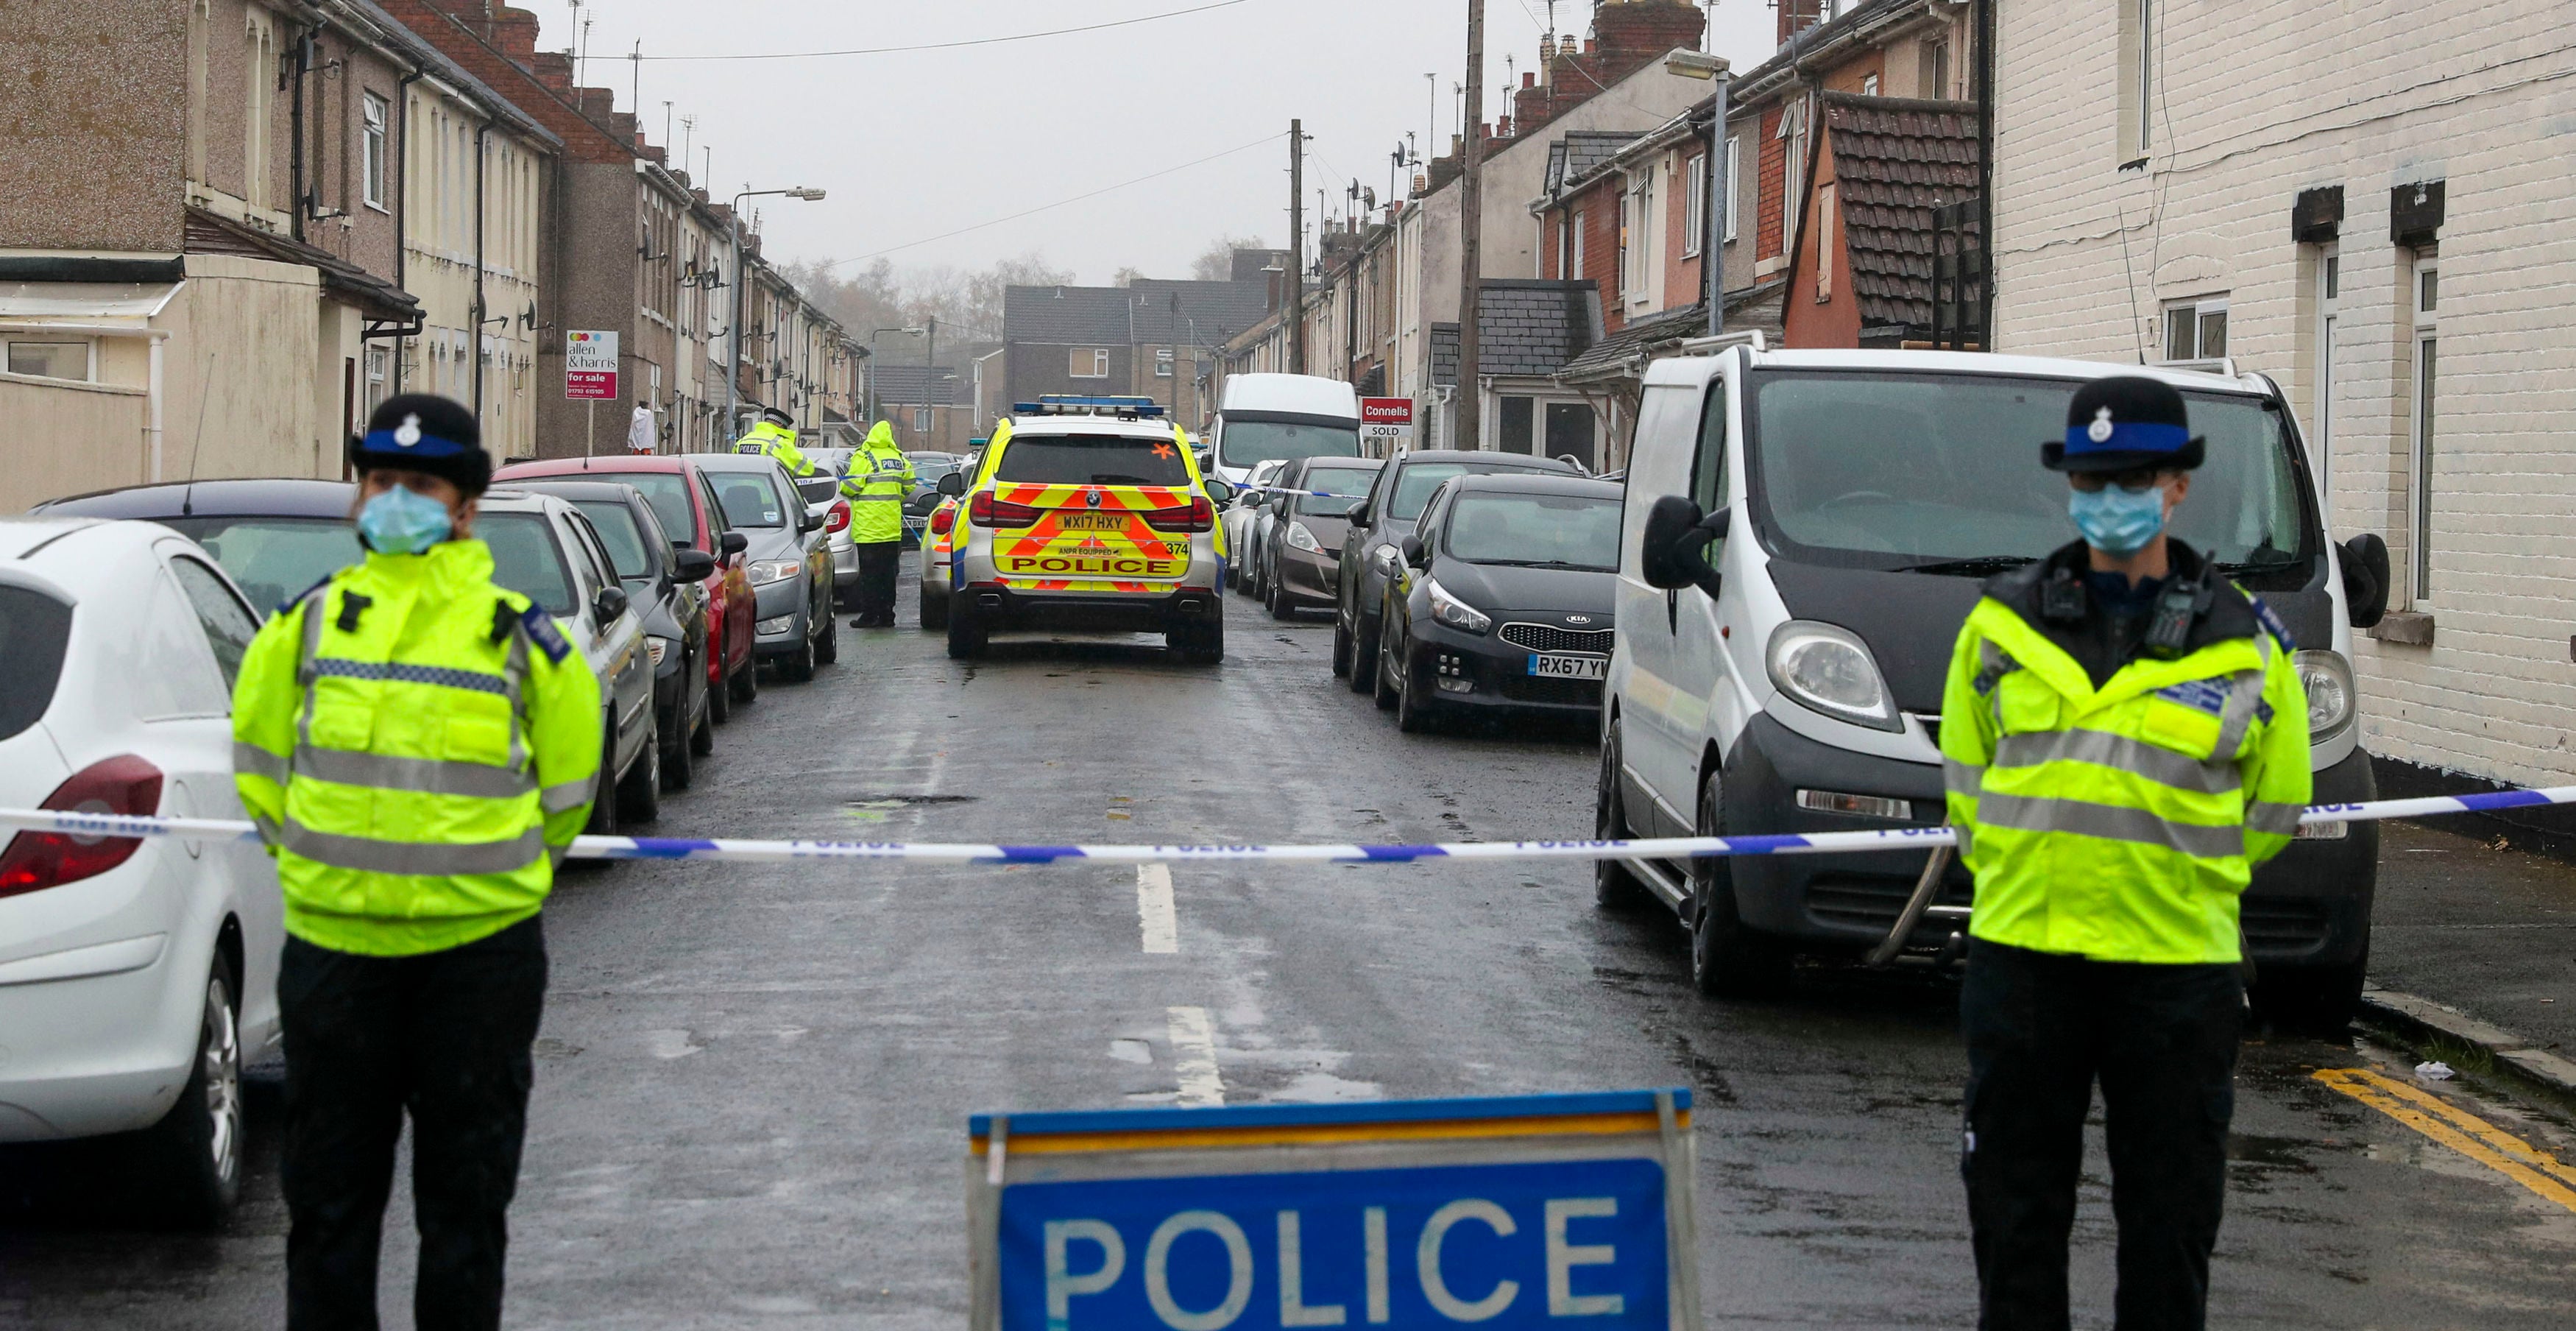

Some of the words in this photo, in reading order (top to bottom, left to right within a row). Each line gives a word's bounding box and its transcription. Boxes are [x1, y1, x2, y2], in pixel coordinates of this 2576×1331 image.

[569, 343, 595, 355] allen
[568, 356, 578, 367] &
[581, 356, 616, 368] harris
[568, 373, 583, 381] for
[585, 373, 605, 382] sale
[1366, 406, 1408, 416] Connells
[1372, 427, 1399, 436] SOLD
[740, 445, 761, 453] POLICE
[882, 460, 902, 470] POLCE
[1064, 516, 1091, 528] WX17
[1097, 517, 1122, 529] HXY
[1167, 543, 1189, 555] 374
[1012, 559, 1172, 573] POLICE
[1539, 657, 1584, 675] RX67
[1044, 1198, 1624, 1331] POLICE
